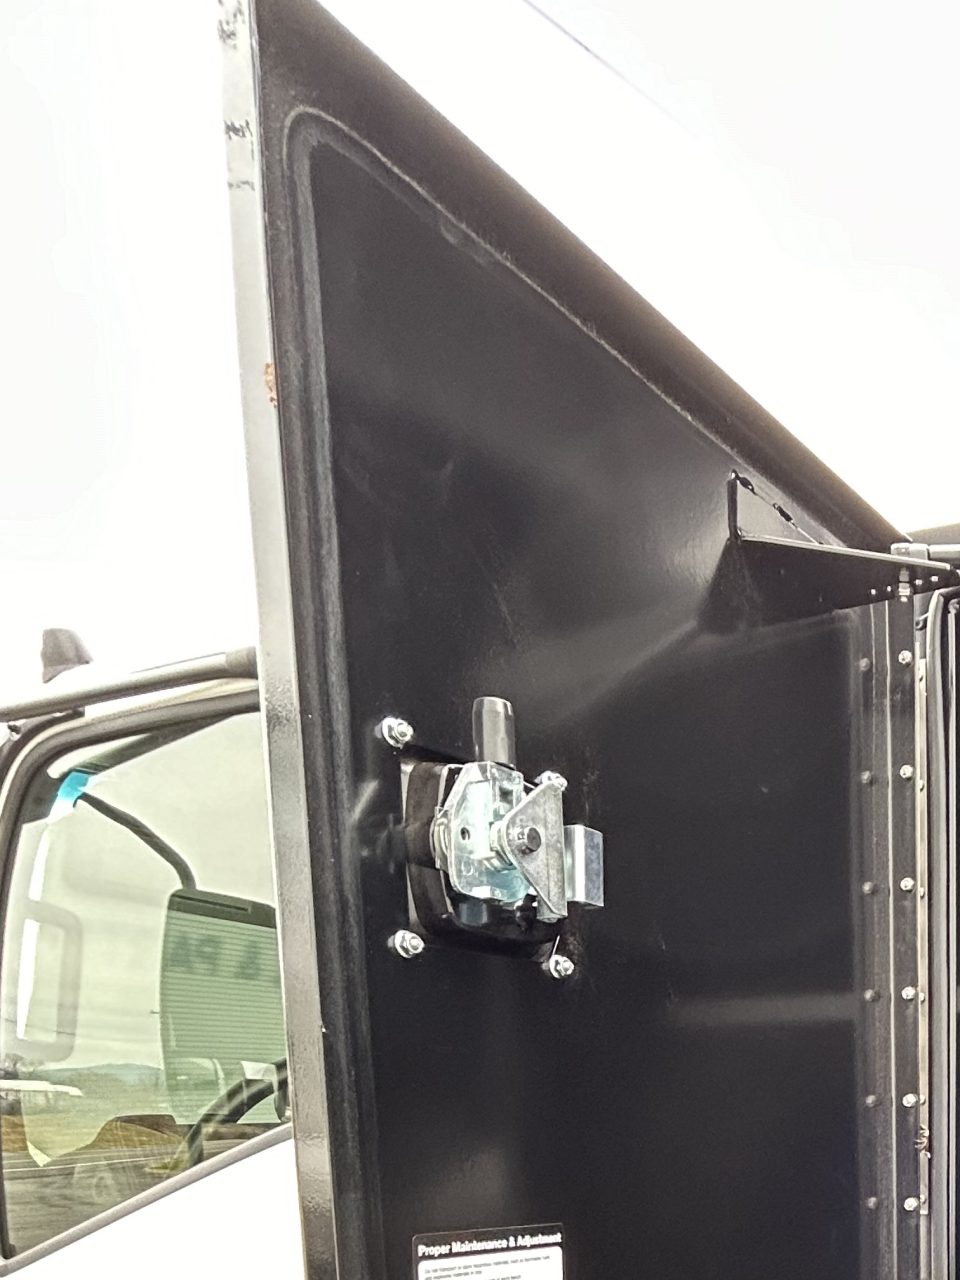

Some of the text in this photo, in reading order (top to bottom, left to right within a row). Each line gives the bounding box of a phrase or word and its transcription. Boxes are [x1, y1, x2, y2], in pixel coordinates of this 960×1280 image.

[417, 1232, 562, 1257] Proper Maintenance & Adjustment
